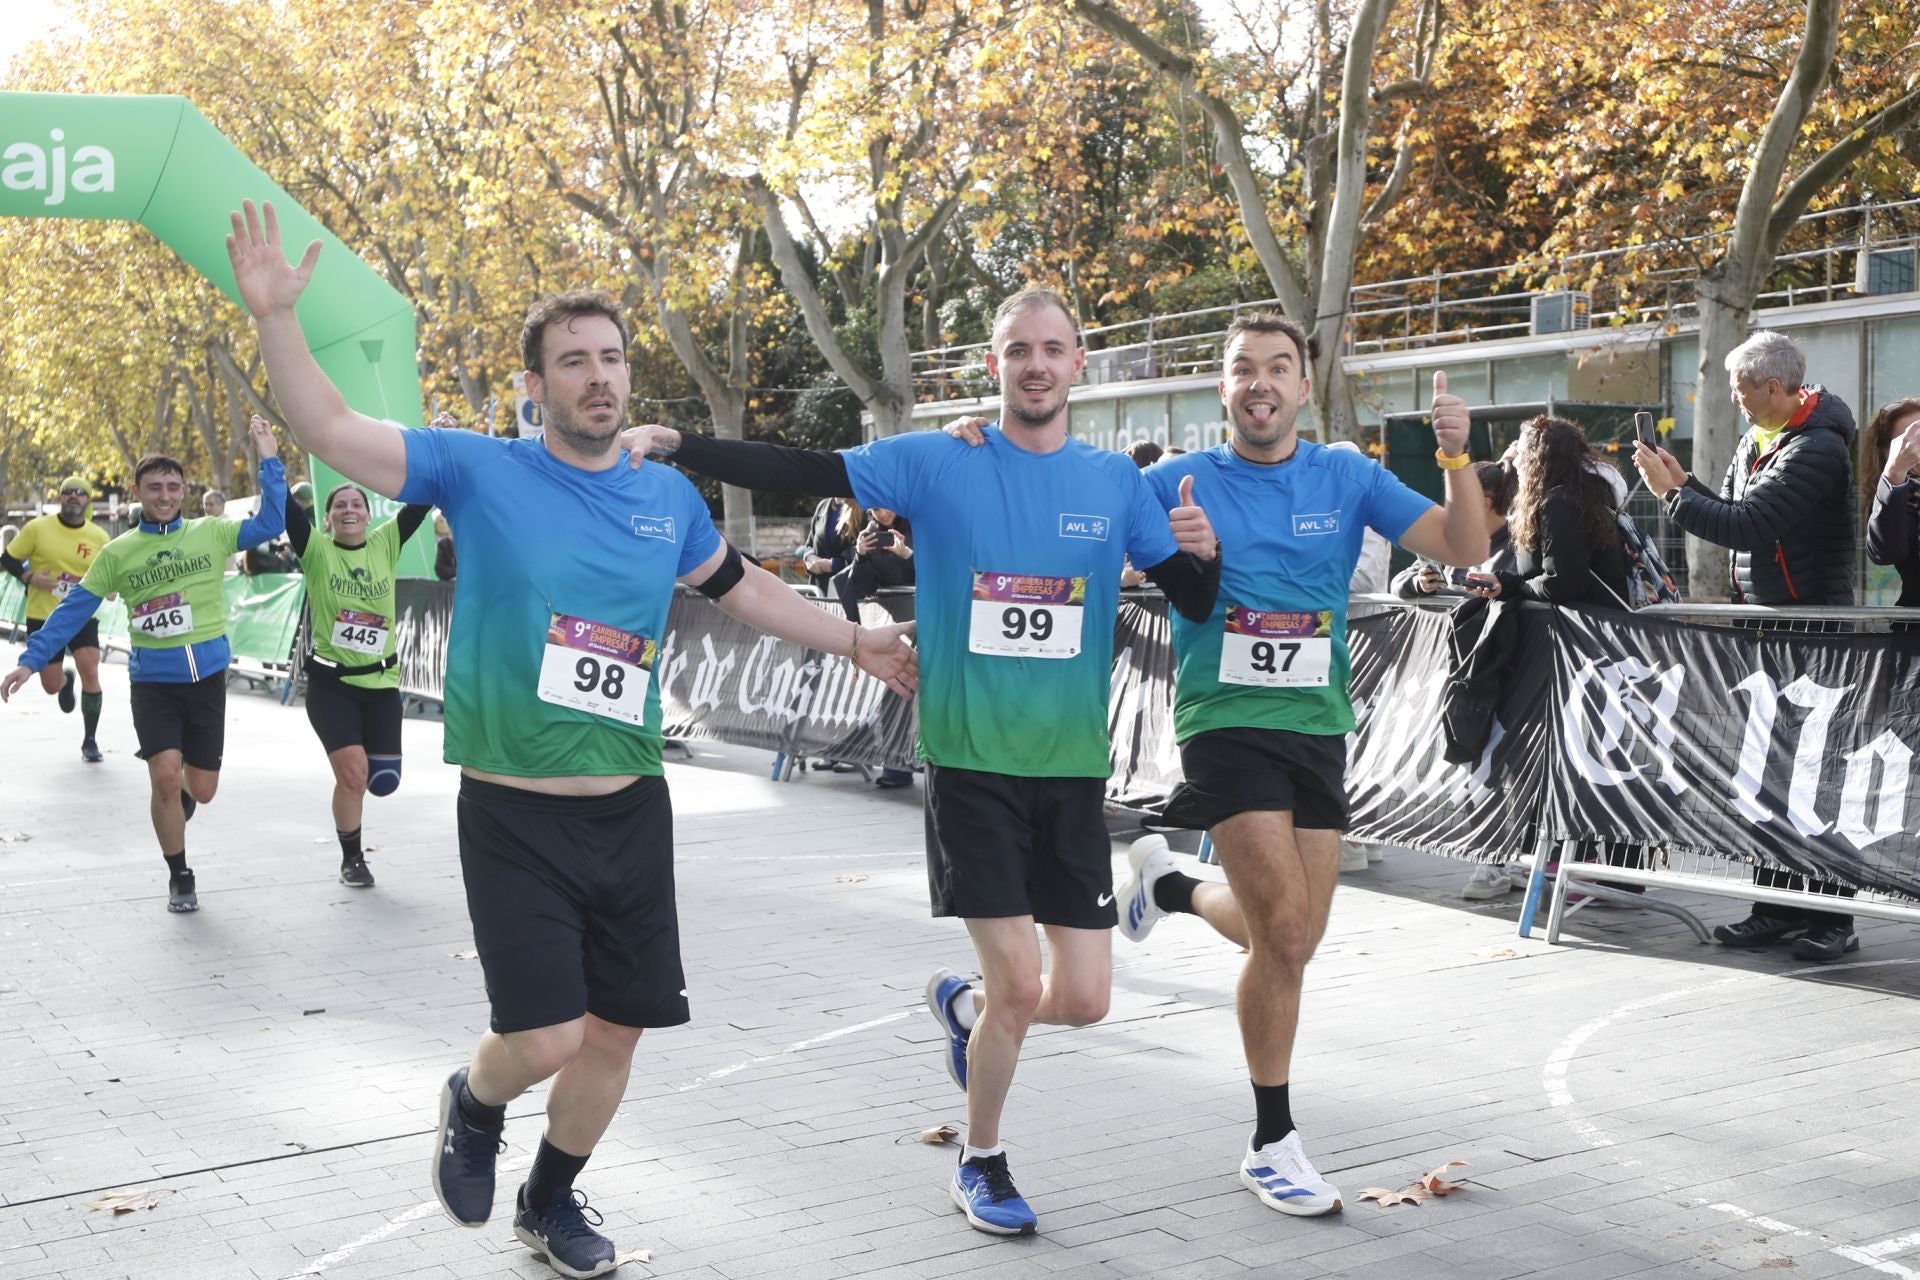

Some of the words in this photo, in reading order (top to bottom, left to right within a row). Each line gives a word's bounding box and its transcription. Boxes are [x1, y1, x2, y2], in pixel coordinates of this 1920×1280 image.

[2, 127, 114, 206] aja
[1065, 522, 1089, 532] AVL
[1299, 521, 1321, 530] AVL
[128, 554, 212, 589] ENTREPINARES
[1012, 584, 1053, 594] EMPRESAS
[141, 609, 184, 632] 446
[1002, 607, 1053, 641] 99
[340, 626, 378, 645] 445
[590, 632, 629, 651] EMPRESAS
[591, 624, 622, 640] CARRERA
[622, 632, 631, 643] DE
[1250, 641, 1301, 672] 97
[573, 656, 625, 700] 98
[689, 632, 735, 712] de
